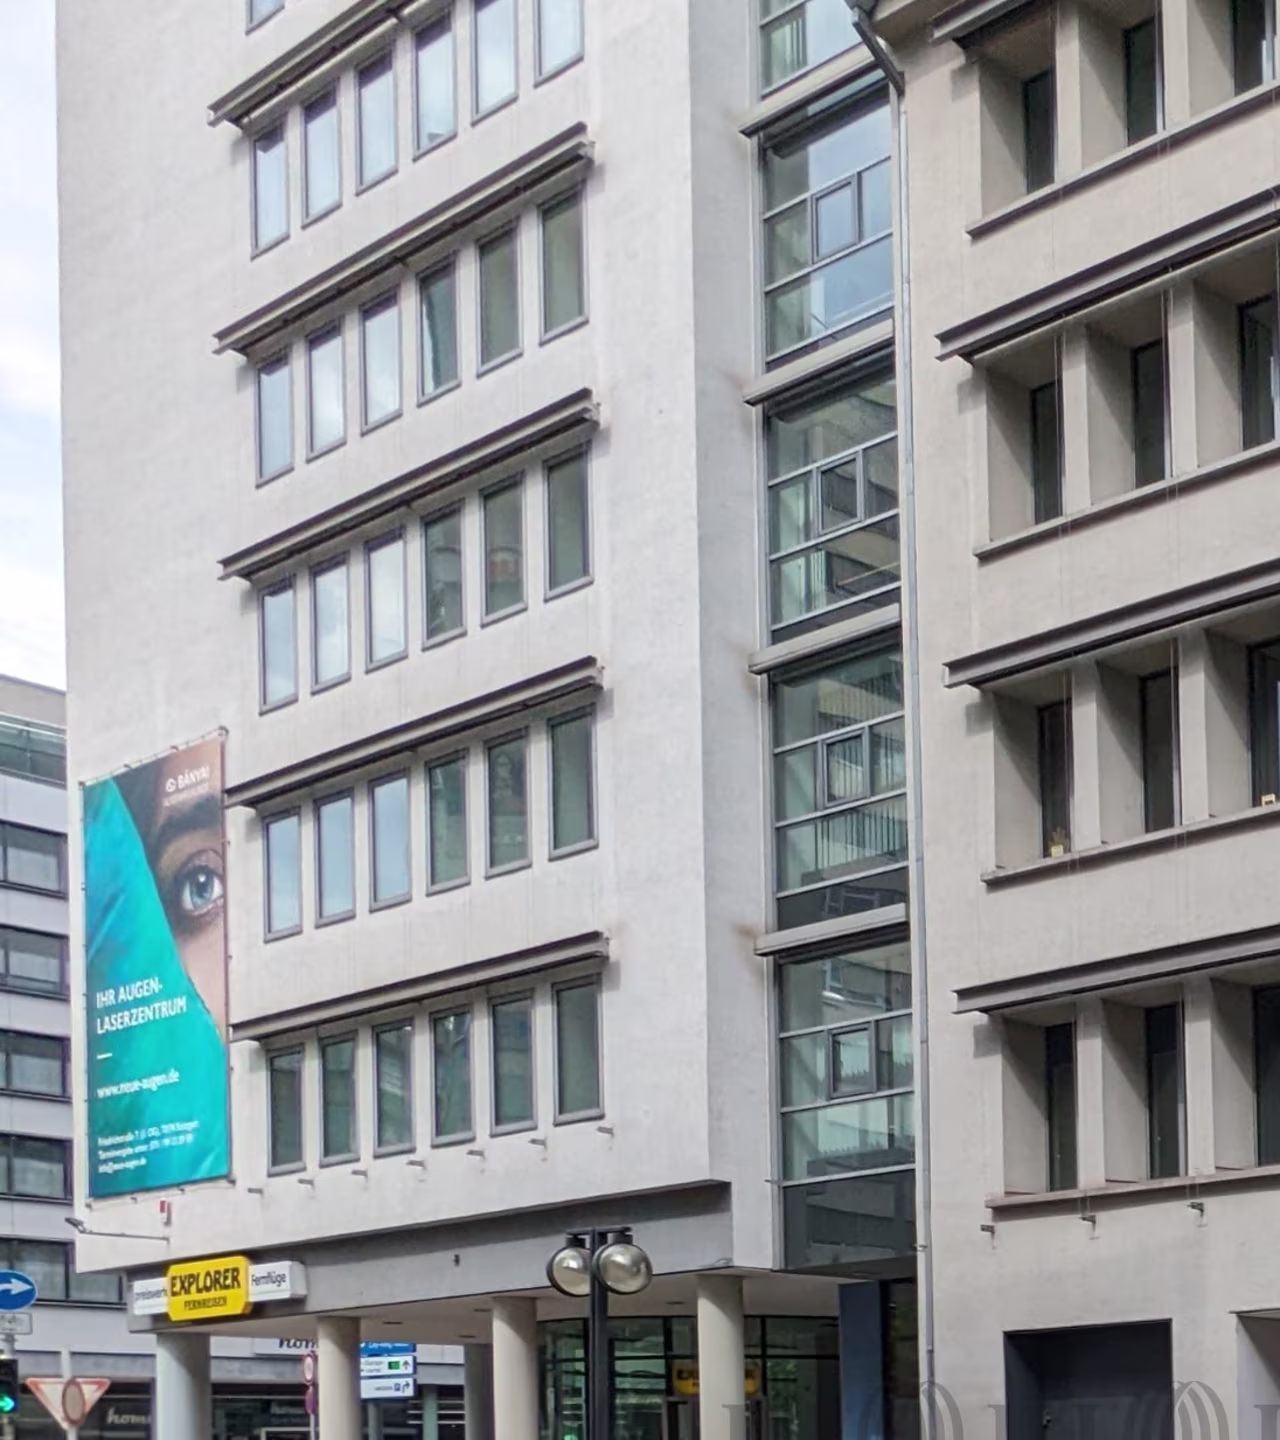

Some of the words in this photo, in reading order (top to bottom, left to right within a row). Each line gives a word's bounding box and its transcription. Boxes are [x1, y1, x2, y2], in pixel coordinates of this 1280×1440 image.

[97, 989, 117, 1009] IHR
[118, 976, 163, 1003] AUGEN-
[97, 995, 188, 1035] LASERZENTRUM
[170, 1267, 241, 1297] EXPLORER
